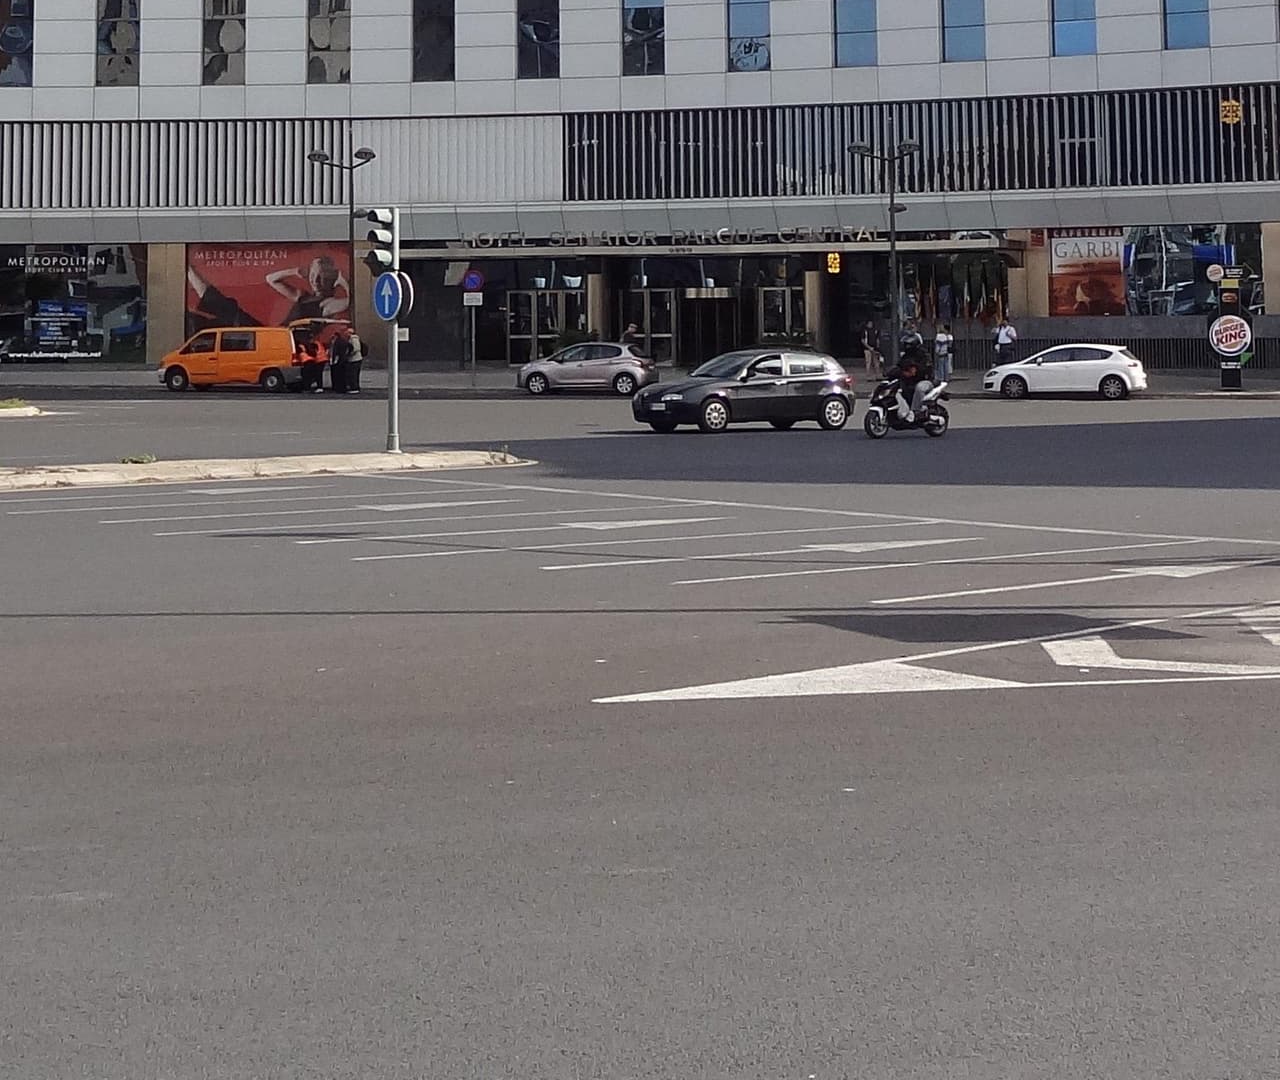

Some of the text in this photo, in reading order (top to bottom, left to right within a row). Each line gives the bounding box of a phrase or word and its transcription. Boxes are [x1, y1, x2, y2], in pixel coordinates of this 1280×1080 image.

[461, 231, 536, 248] HOTEL
[549, 230, 657, 247] SENATOR
[778, 226, 888, 244] CENTRAL
[1053, 228, 1121, 237] CAFETERIA
[194, 250, 288, 260] METROPOLITAN
[1054, 241, 1120, 258] GARBI
[8, 256, 105, 266] METROPOLITAN
[1214, 322, 1245, 336] BURGER
[1216, 330, 1247, 346] KING
